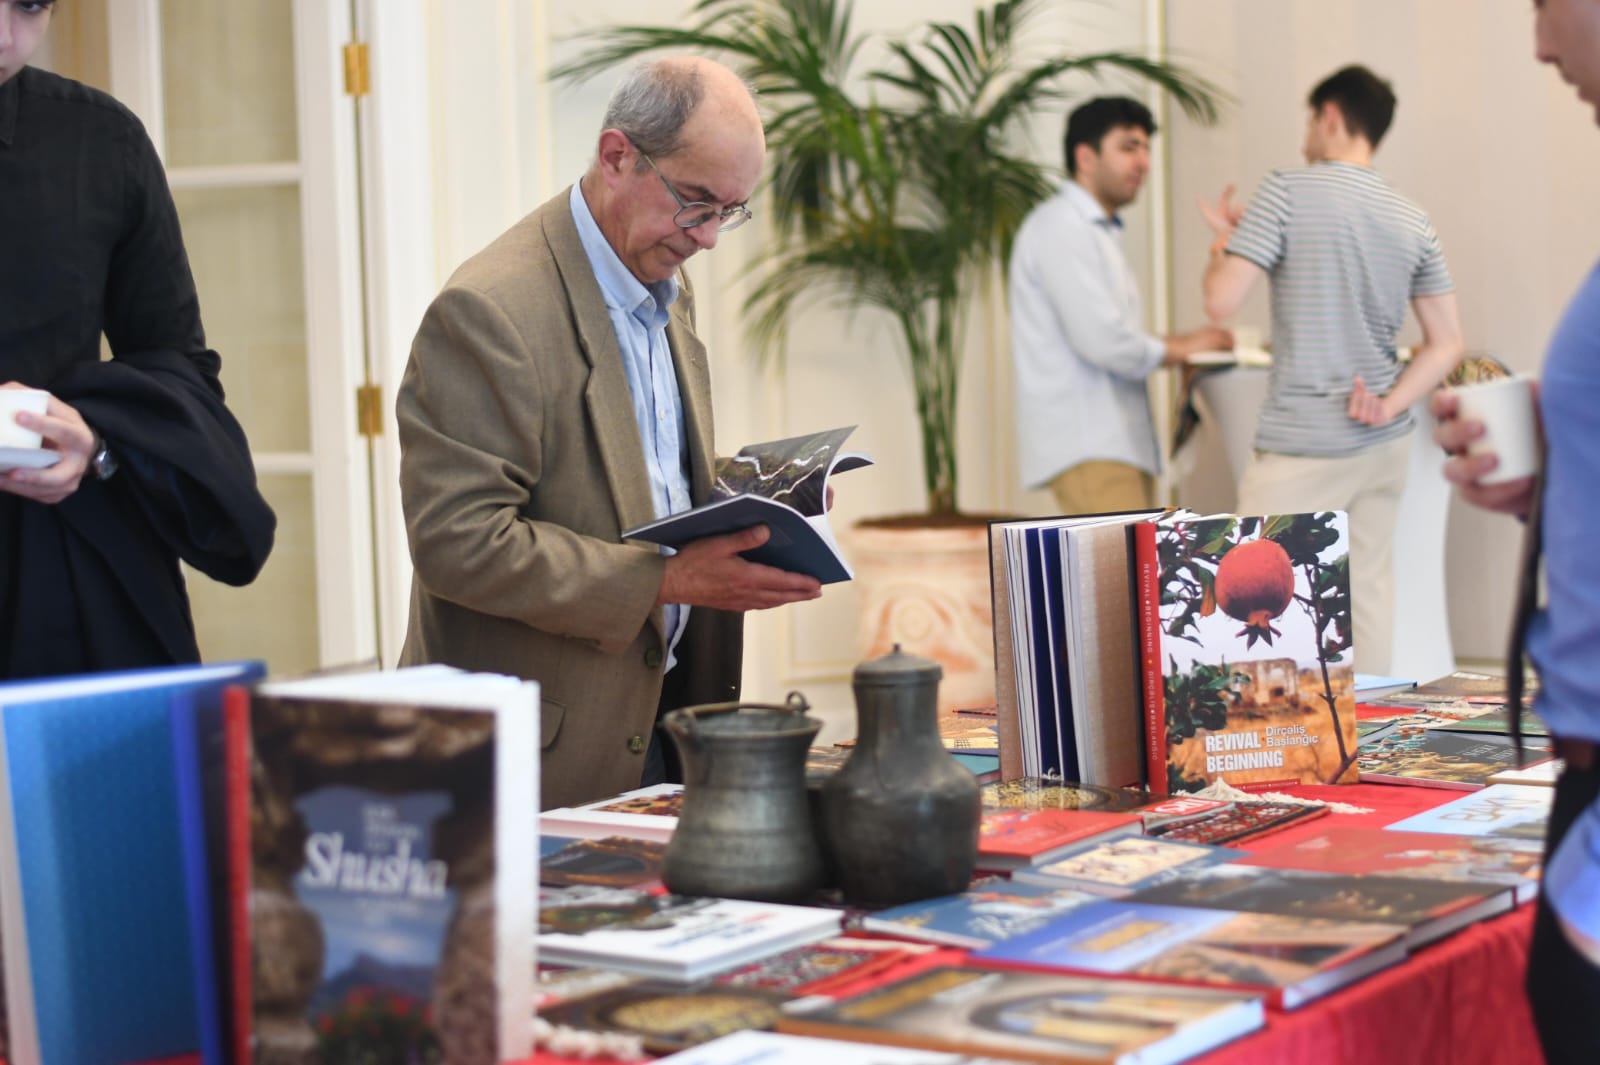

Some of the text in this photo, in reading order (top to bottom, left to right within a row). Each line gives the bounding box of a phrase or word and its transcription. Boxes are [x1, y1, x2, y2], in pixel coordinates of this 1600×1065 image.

[1205, 732, 1261, 753] REVIVAL
[1206, 750, 1283, 773] BEGINNING
[301, 831, 449, 898] Shusha
